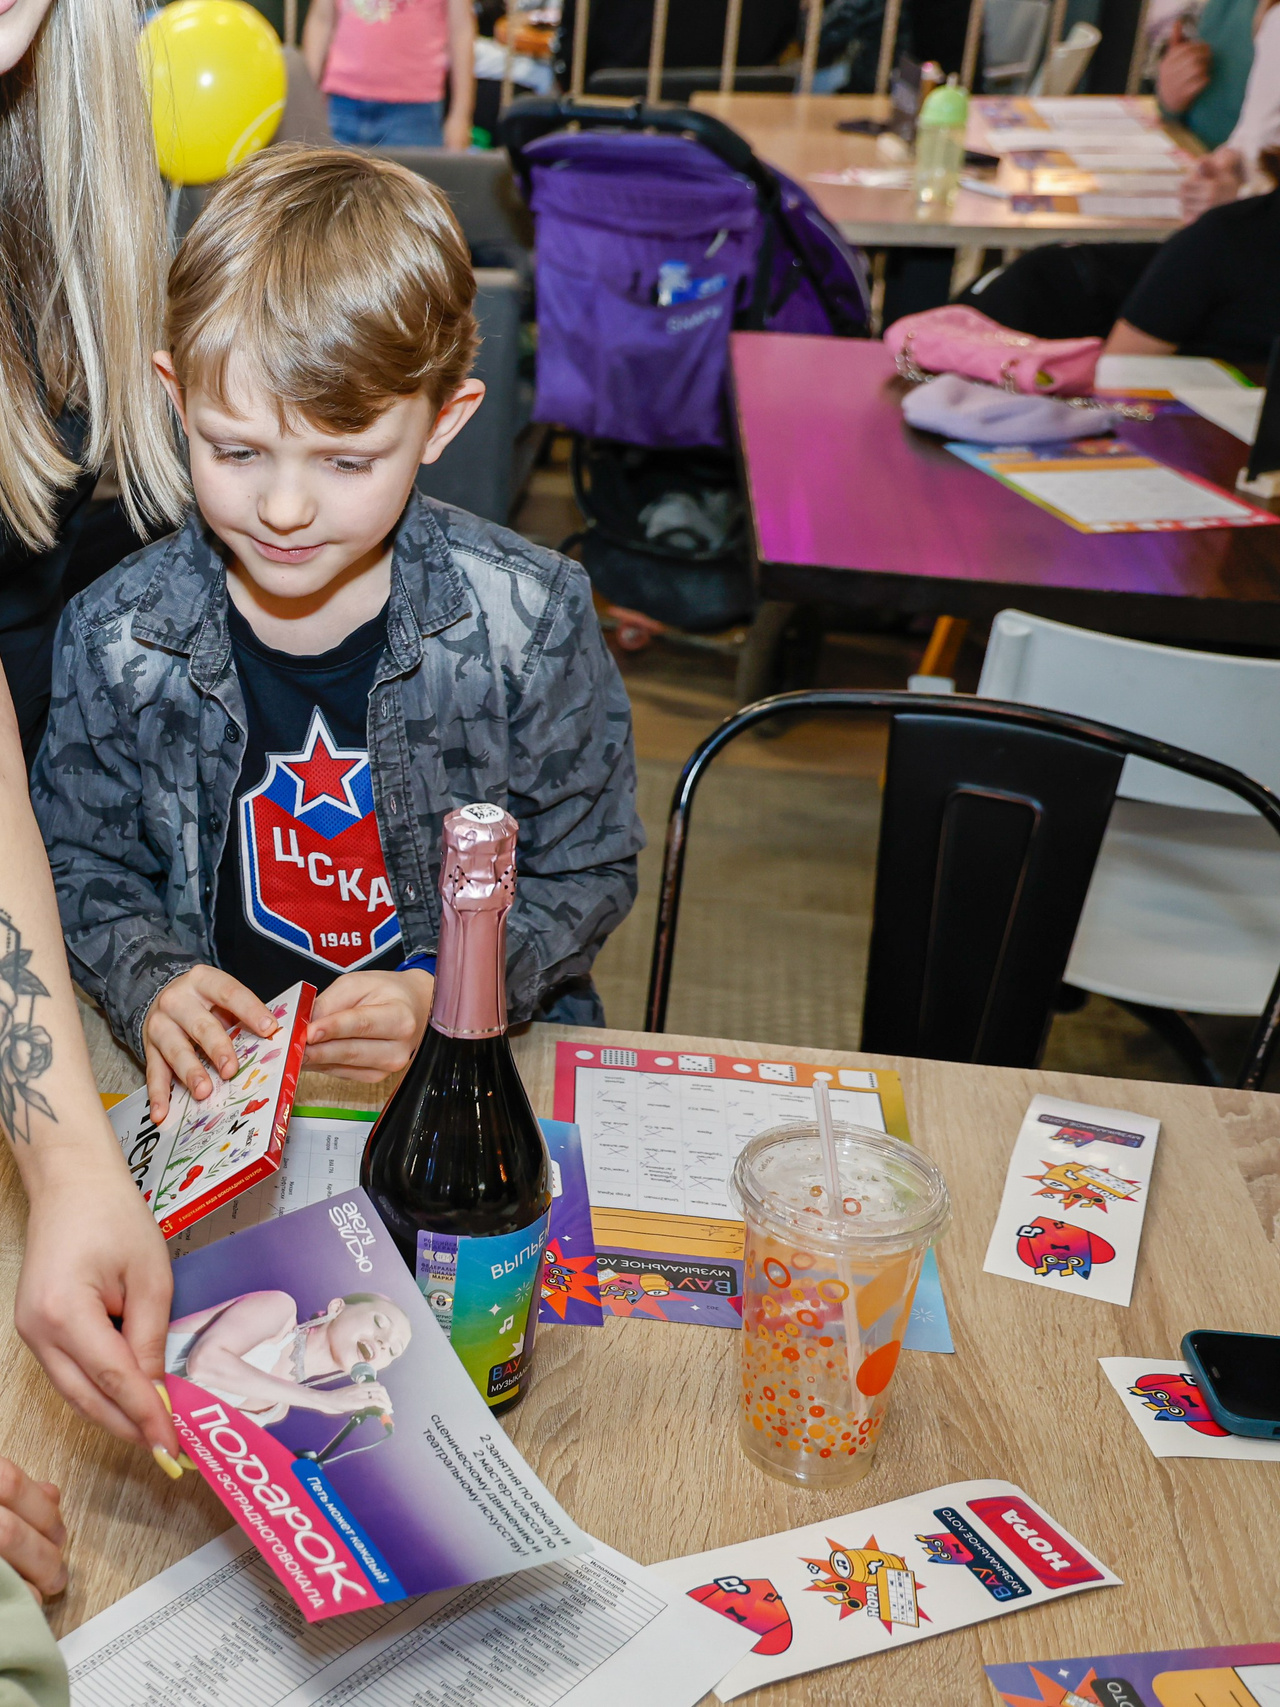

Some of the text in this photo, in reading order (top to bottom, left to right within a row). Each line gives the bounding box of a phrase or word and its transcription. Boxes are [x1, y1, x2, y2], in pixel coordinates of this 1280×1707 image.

[273, 826, 394, 912] ЦСКА
[320, 932, 362, 947] 1946
[432, 1272, 453, 1283] МАРКА
[596, 1257, 729, 1277] МУЗЫКАЛЬНОЕ ЛО
[676, 1275, 730, 1294] ВАУ
[491, 1356, 522, 1382] ВАУ
[179, 1427, 224, 1474] СТУДИИ
[480, 1433, 492, 1443] 2
[430, 1413, 492, 1493] сценическому
[485, 1492, 536, 1546] движению
[485, 1443, 523, 1487] занятия
[422, 1428, 531, 1558] театральному искусству!
[472, 1449, 558, 1550] 2 мастер-класса по
[518, 1485, 534, 1501] по
[306, 1476, 390, 1584] Петь может каждый!
[530, 1500, 566, 1537] вокалу
[941, 1508, 1026, 1594] МУЗЫКАЛЬНОЕ ЛОТО
[1001, 1508, 1071, 1573] НОРА
[573, 1568, 619, 1599] Мурат Насыров
[579, 1563, 626, 1593] Сергей Лазарев
[589, 1559, 628, 1585] Исполнитель
[971, 1567, 1012, 1600] ВАУ
[561, 1580, 607, 1610] Ольга Зарубина
[563, 1571, 618, 1608] Наталья Ветлицкая
[568, 1594, 587, 1607] ПИКА
[865, 1585, 881, 1618] НОРА
[257, 1601, 280, 1617] Татьяна
[538, 1601, 581, 1630] Юрий Антонов
[556, 1604, 575, 1617] Слава
[559, 1597, 584, 1614] Ранетки
[236, 1616, 284, 1650] Тима Белорусских
[515, 1615, 538, 1630] Наташа
[527, 1604, 579, 1638] Татьяна Овсиенко
[531, 1615, 563, 1636] Radiohead
[229, 1621, 277, 1655] Филипп Киркоров
[484, 1632, 546, 1672] Отпетые Мошенники
[521, 1637, 534, 1646] Яна
[529, 1633, 553, 1649] Виктор
[550, 1646, 580, 1667] Салтыков
[191, 1654, 230, 1682] Андрей Губин
[209, 1657, 226, 1669] Баста
[210, 1647, 230, 1662] Город
[490, 1654, 513, 1670] Краски
[492, 1646, 519, 1664] Мишель
[453, 1650, 485, 1672] Трофимов
[486, 1672, 514, 1691] Комната
